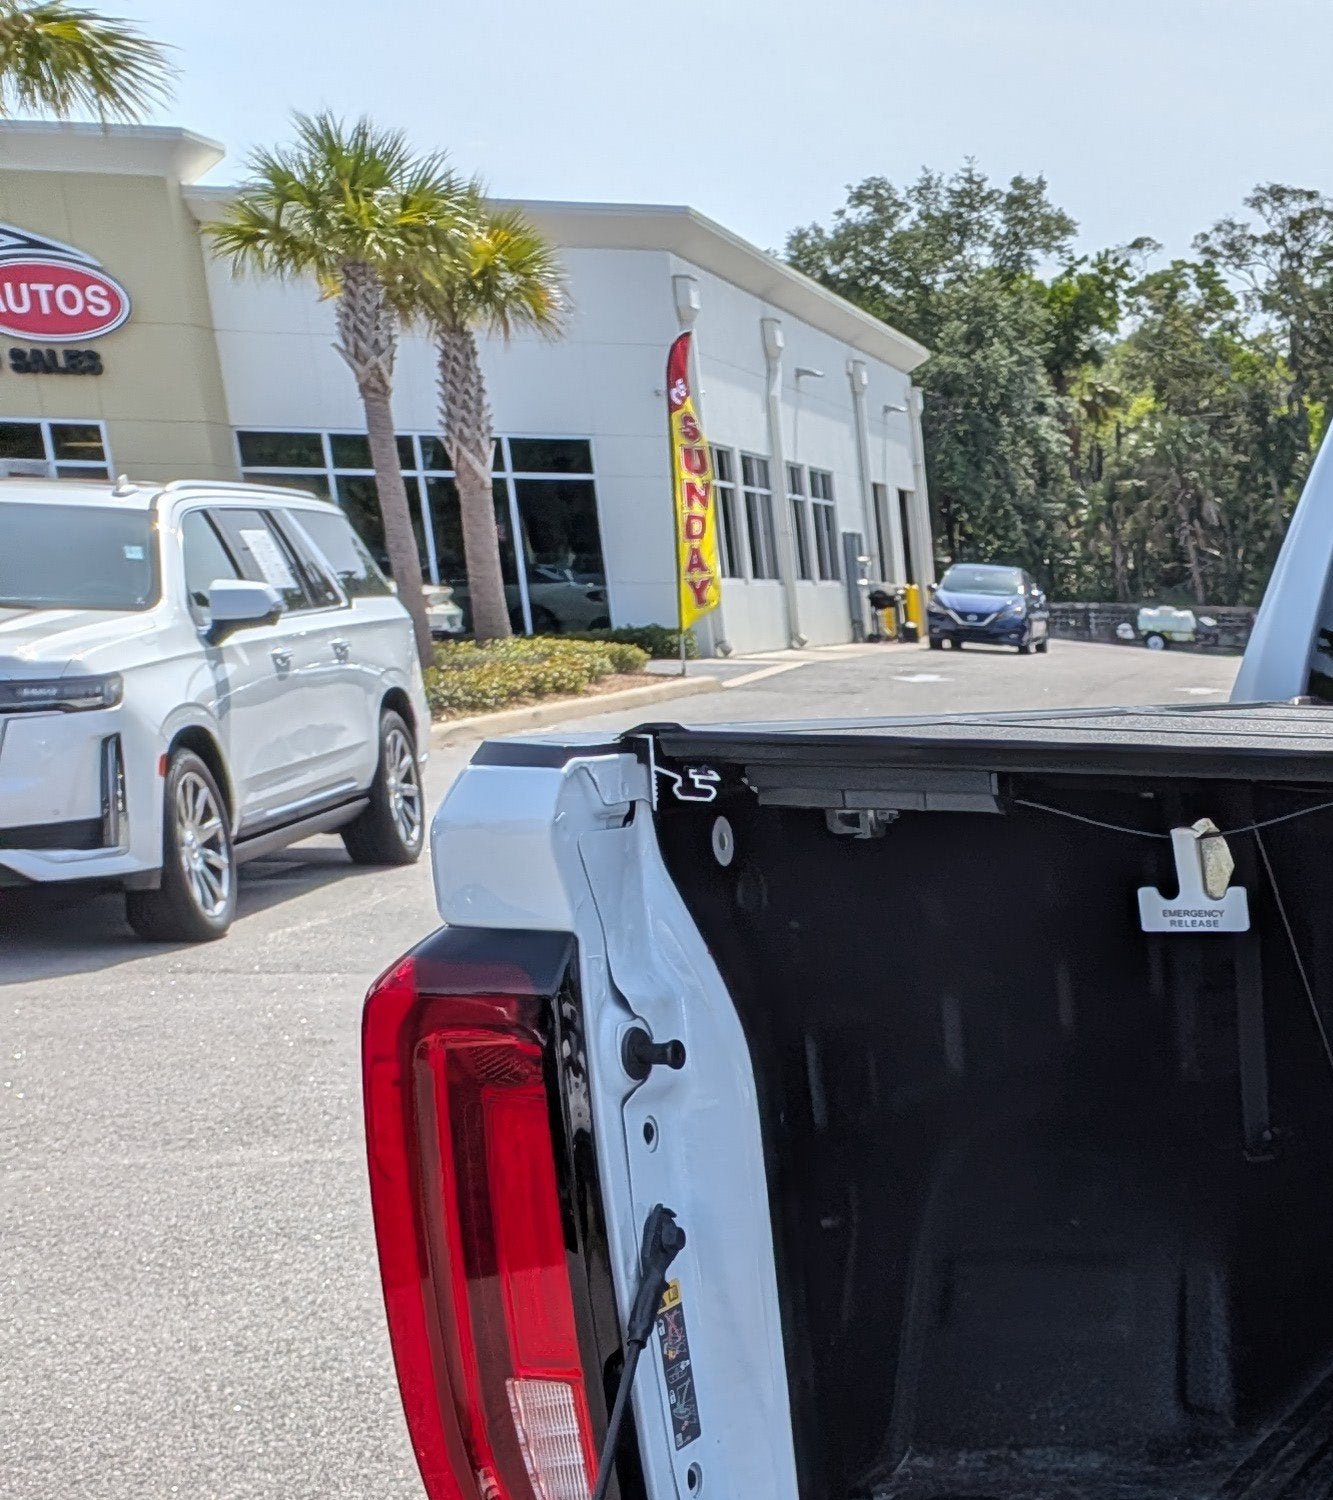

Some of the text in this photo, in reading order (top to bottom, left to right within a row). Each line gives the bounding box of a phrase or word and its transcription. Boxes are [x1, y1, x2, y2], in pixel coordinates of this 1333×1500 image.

[0, 282, 111, 317] UTOS
[9, 347, 103, 375] SALES
[680, 412, 713, 608] SUNDAY
[1162, 909, 1225, 918] EMERGENCY
[1170, 919, 1219, 928] RELEASE
